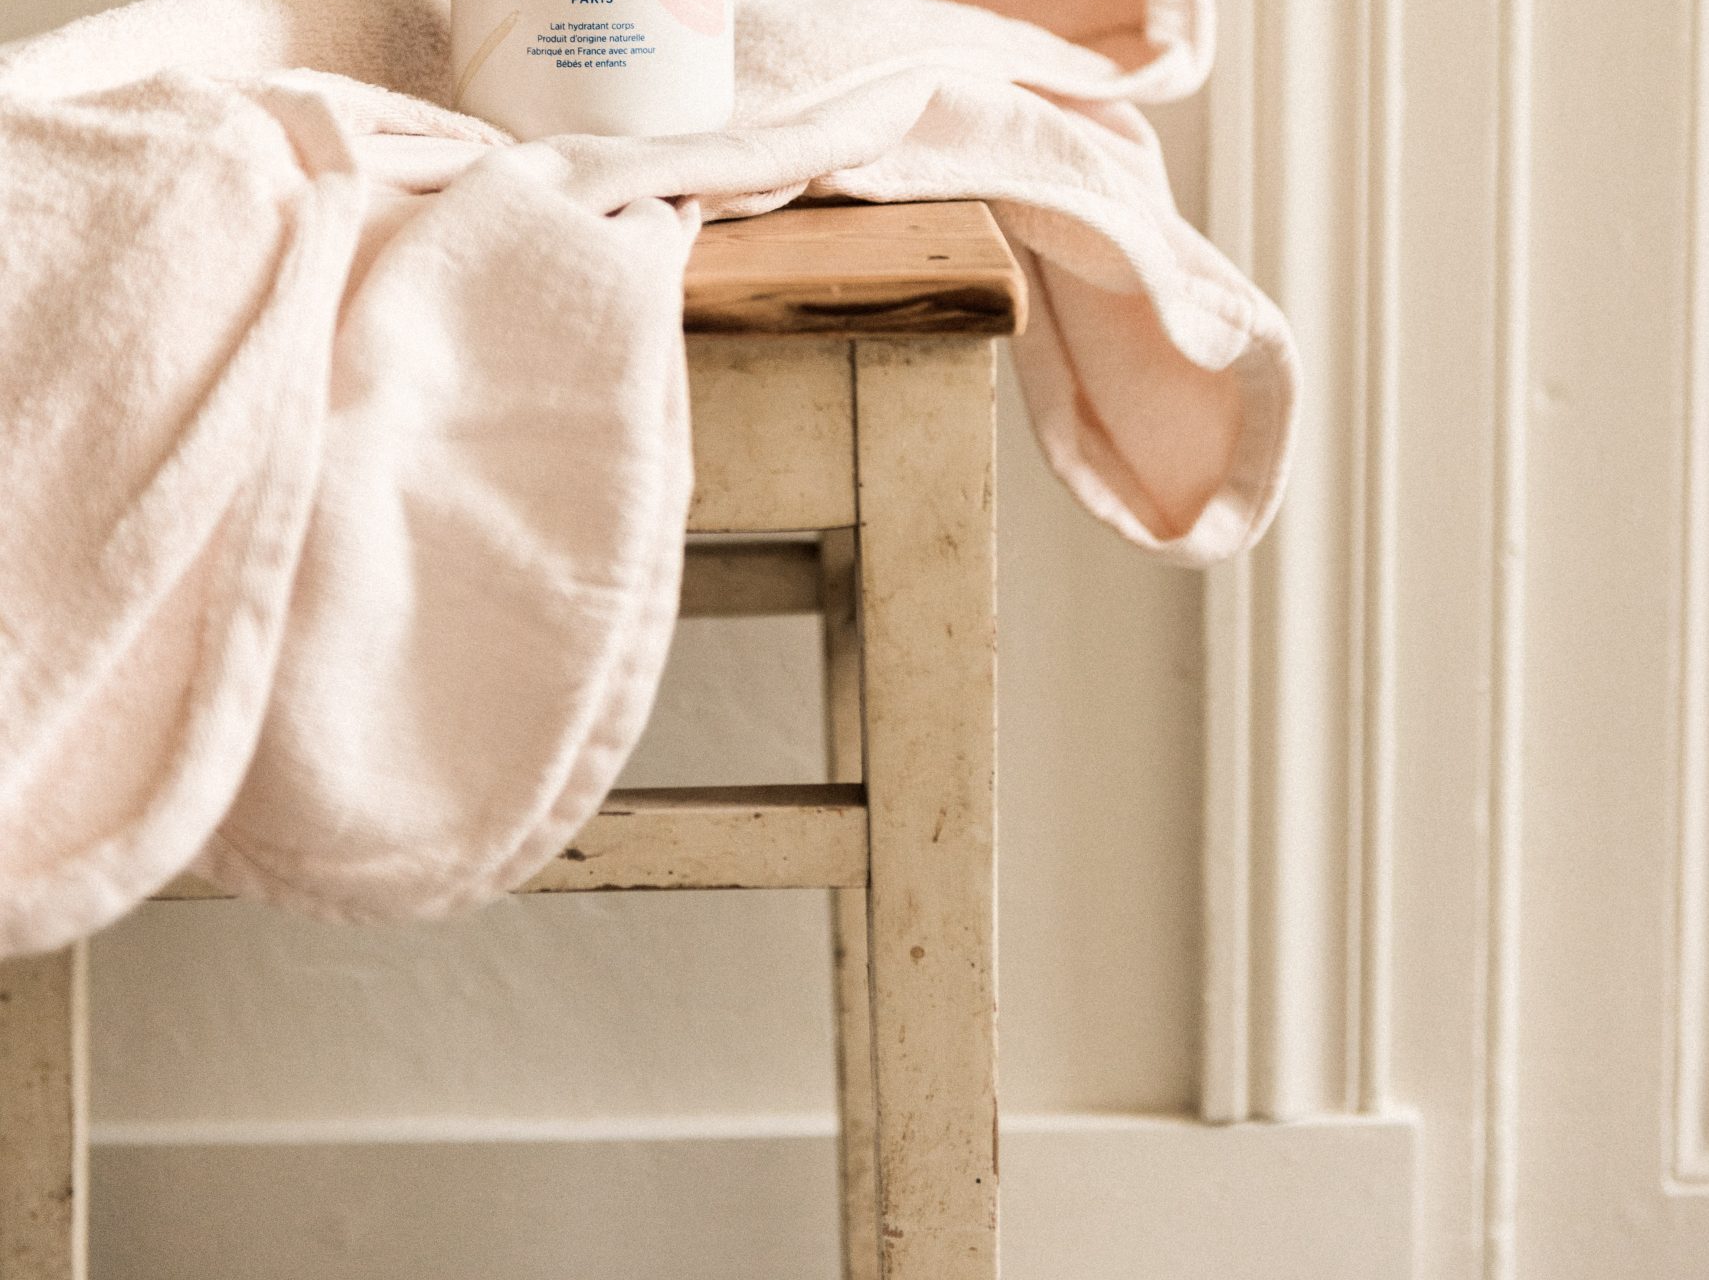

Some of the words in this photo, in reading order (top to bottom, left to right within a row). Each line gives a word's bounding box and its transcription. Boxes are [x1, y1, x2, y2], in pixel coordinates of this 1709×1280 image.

[550, 22, 566, 31] Lait
[568, 22, 609, 32] hydratant
[611, 22, 635, 31] corps
[537, 34, 567, 43] Produit
[609, 33, 646, 42] naturelle
[564, 48, 576, 56] en
[577, 46, 607, 56] France
[608, 47, 628, 56] avec
[630, 46, 656, 55] amour
[556, 59, 583, 68] Bébés
[584, 59, 593, 68] et
[595, 58, 627, 68] enfants
